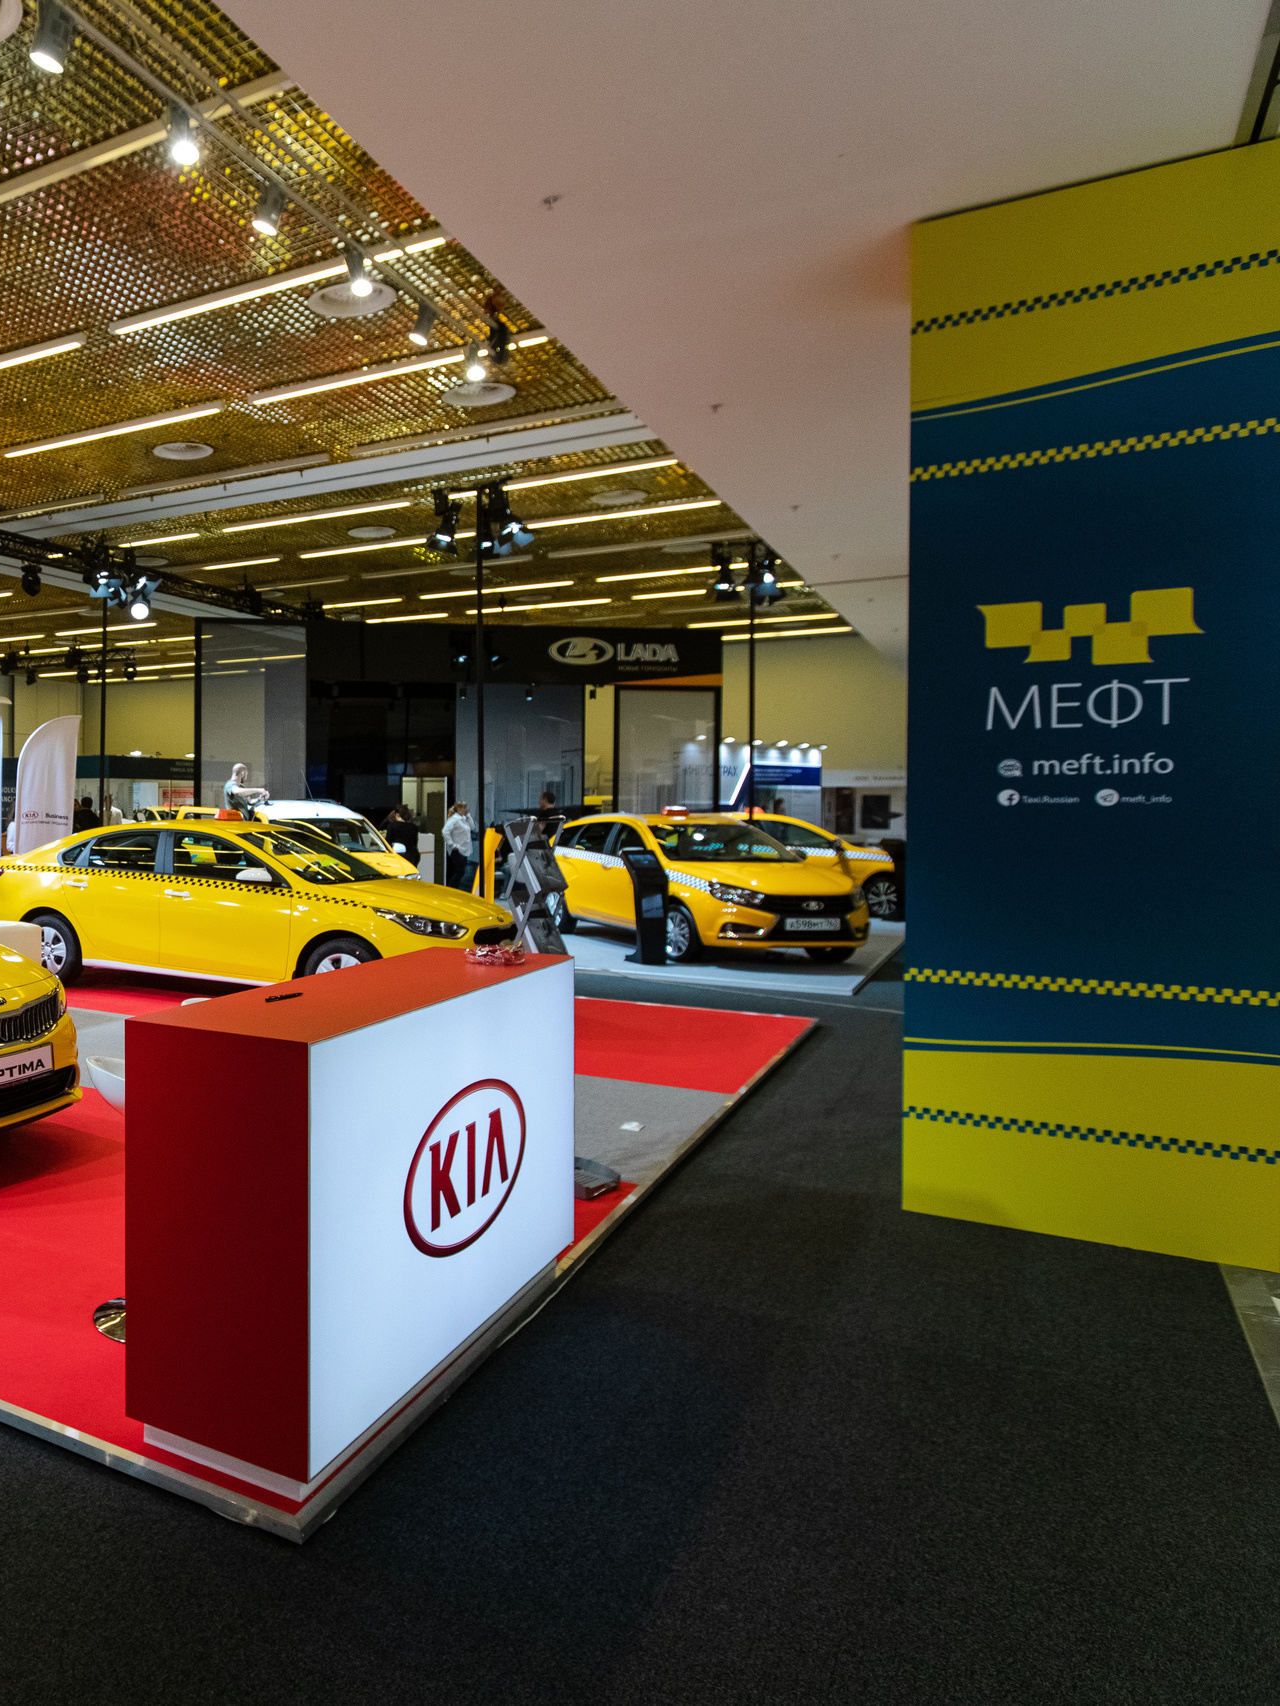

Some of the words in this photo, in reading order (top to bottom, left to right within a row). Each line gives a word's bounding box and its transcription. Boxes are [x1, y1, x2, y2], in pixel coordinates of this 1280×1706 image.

[617, 642, 680, 662] LADA
[985, 677, 1191, 731] МЕФТ
[1032, 752, 1175, 776] meft.info
[429, 1107, 509, 1233] KIA
